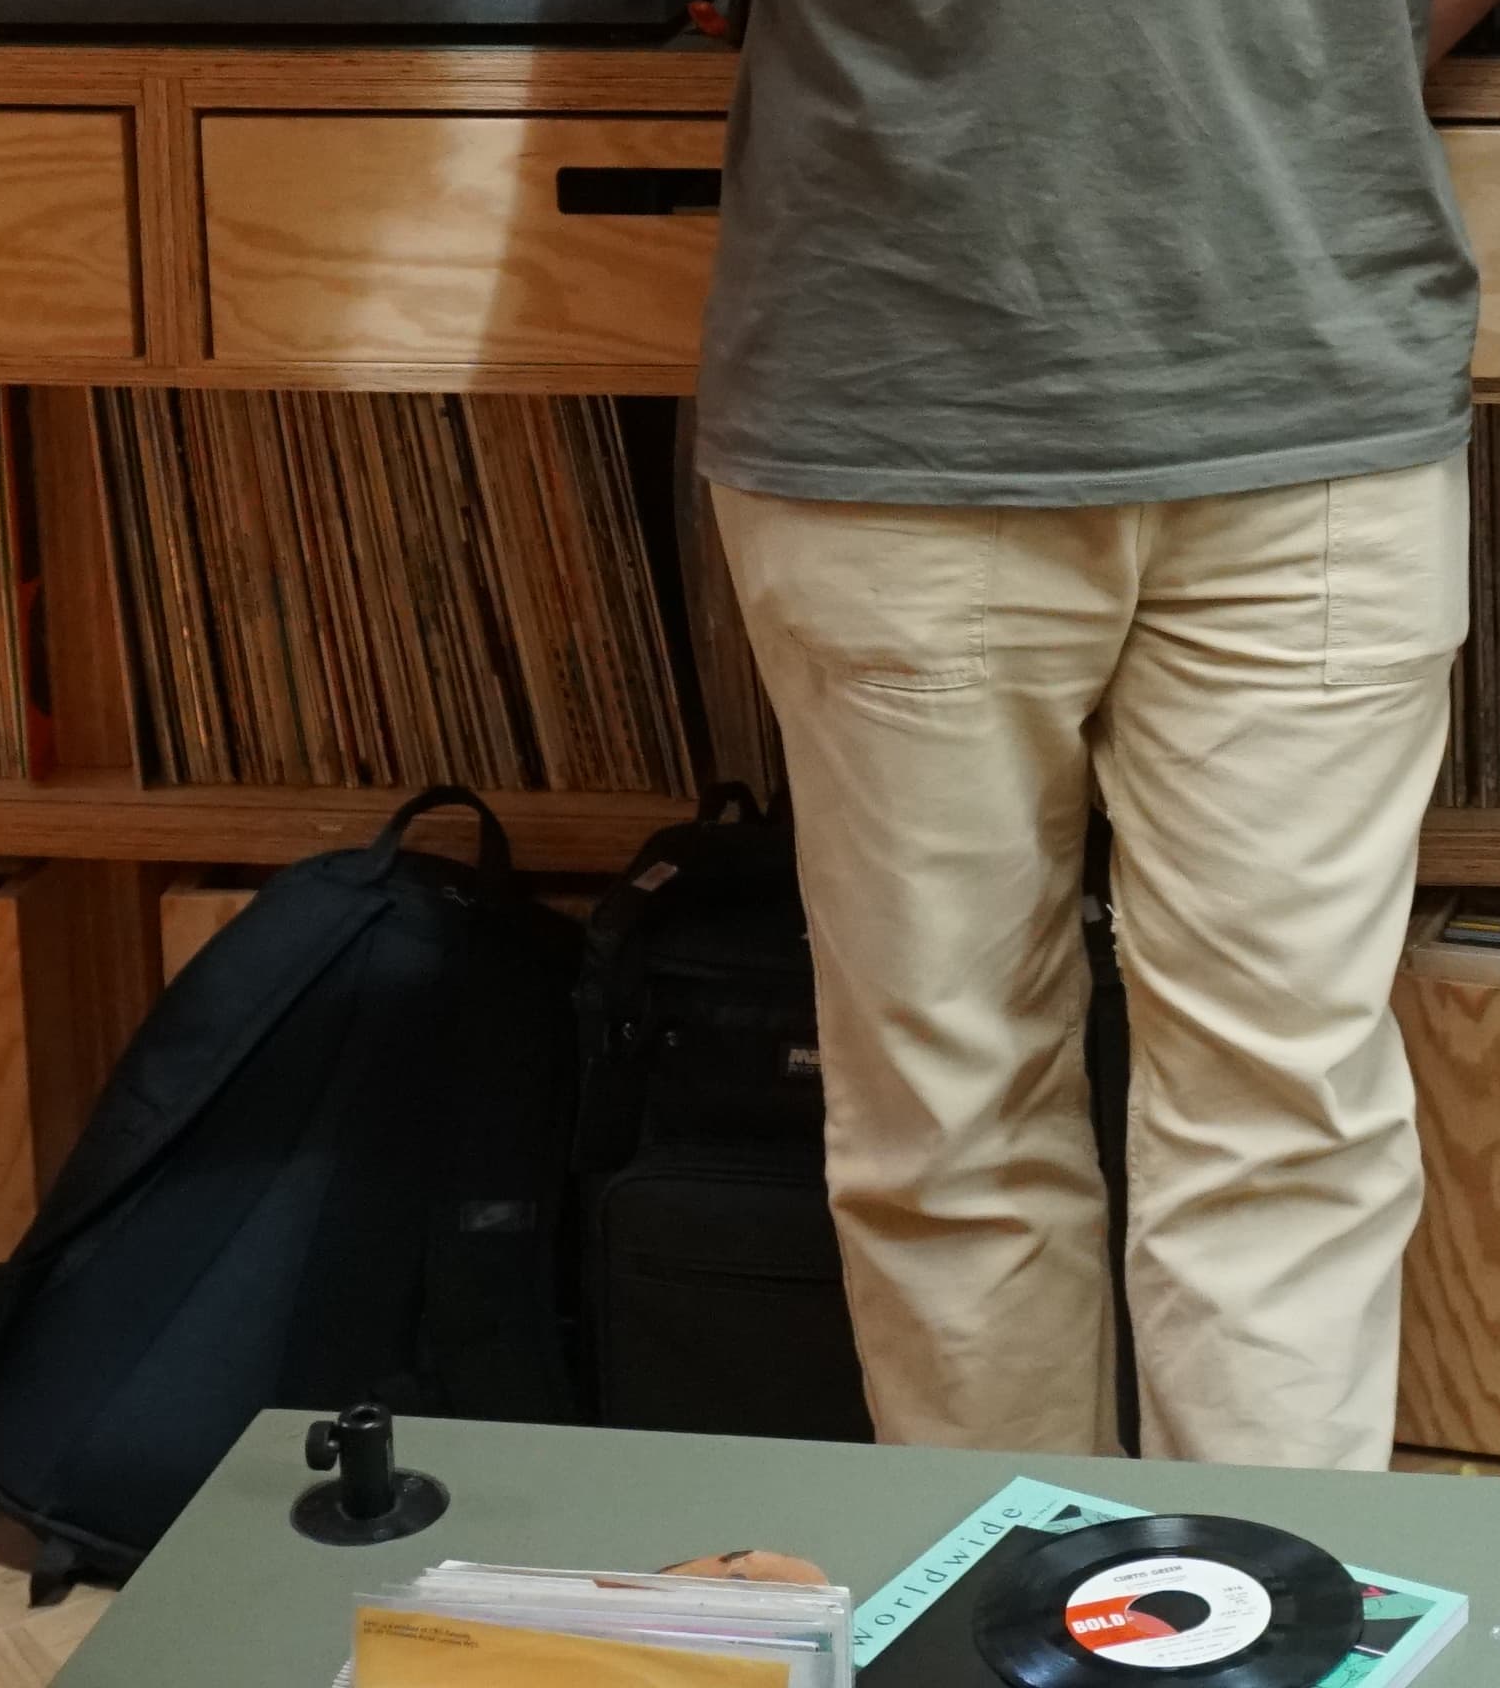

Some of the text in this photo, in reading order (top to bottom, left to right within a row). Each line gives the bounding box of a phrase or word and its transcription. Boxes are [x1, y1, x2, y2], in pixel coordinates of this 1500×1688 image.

[1113, 1572, 1148, 1583] CURTIS
[1151, 1565, 1183, 1576] GREEN
[1071, 1613, 1125, 1634] BOLD
